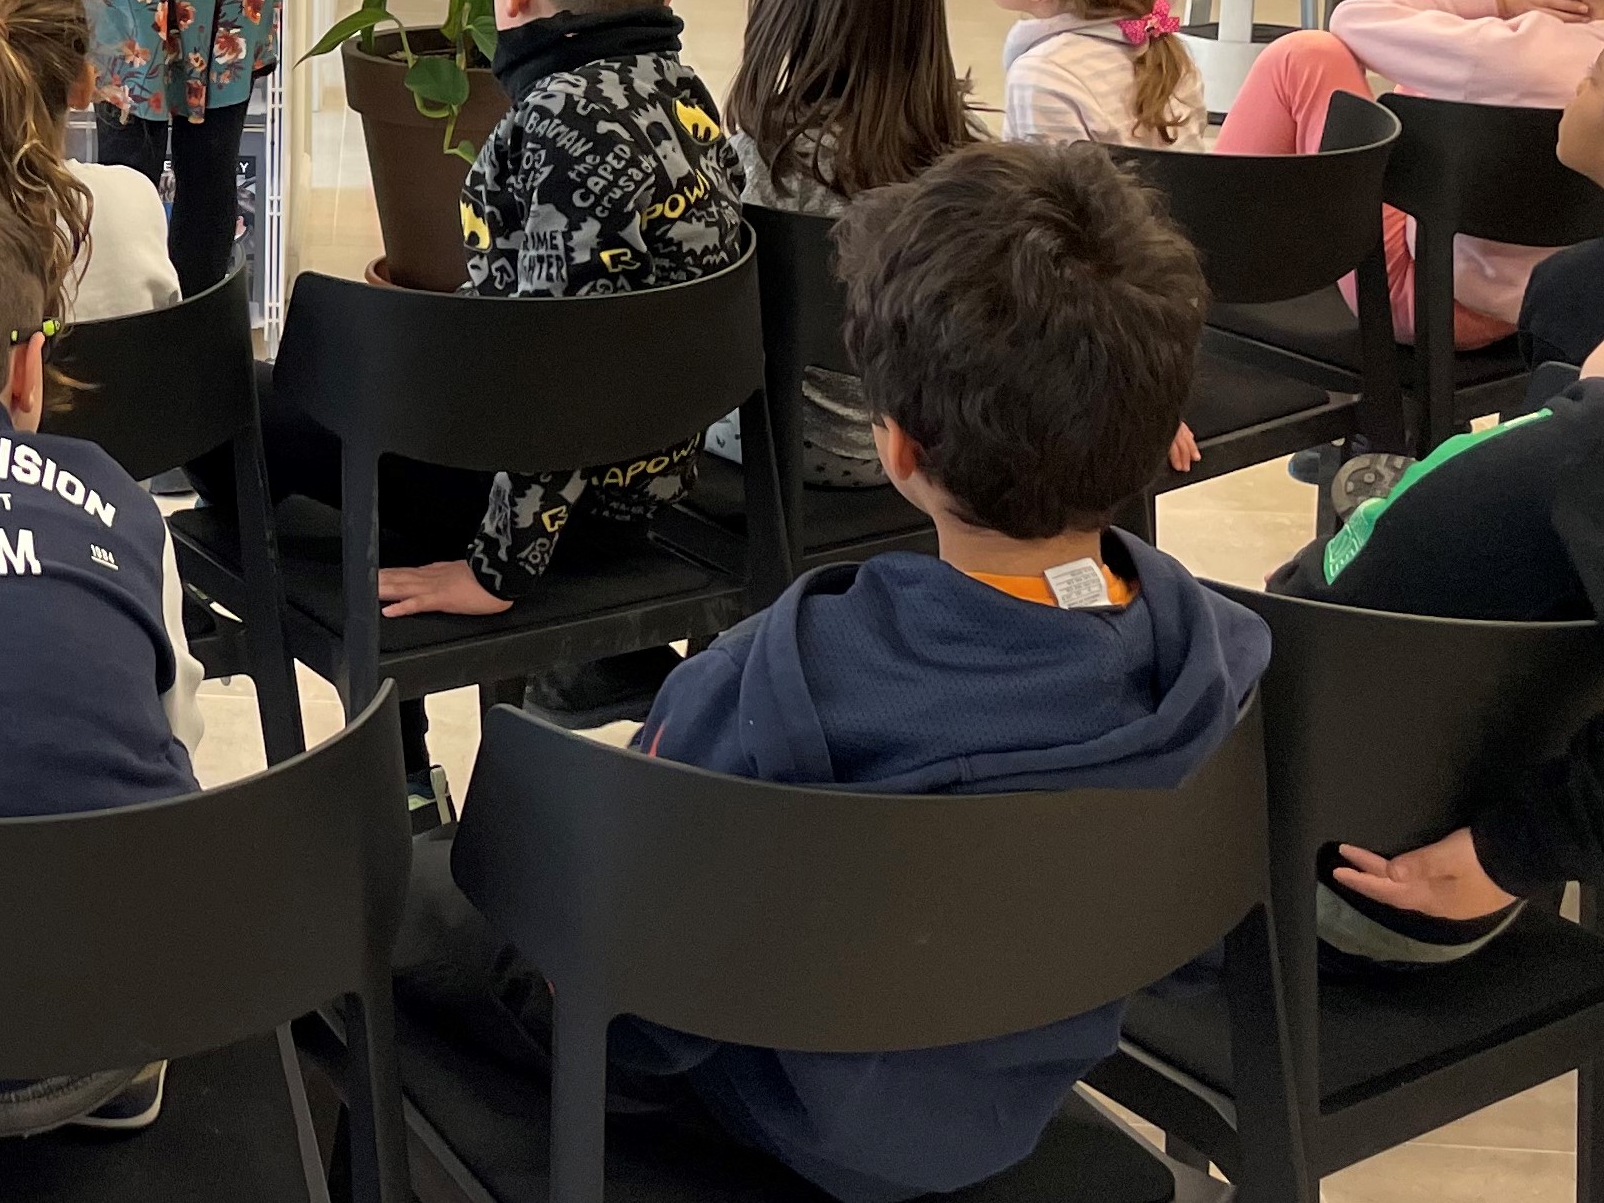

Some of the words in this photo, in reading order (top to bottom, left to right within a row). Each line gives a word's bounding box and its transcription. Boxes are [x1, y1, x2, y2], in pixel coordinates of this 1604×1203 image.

[524, 111, 594, 157] BATMAN
[568, 154, 600, 182] the
[572, 144, 631, 208] CAPED
